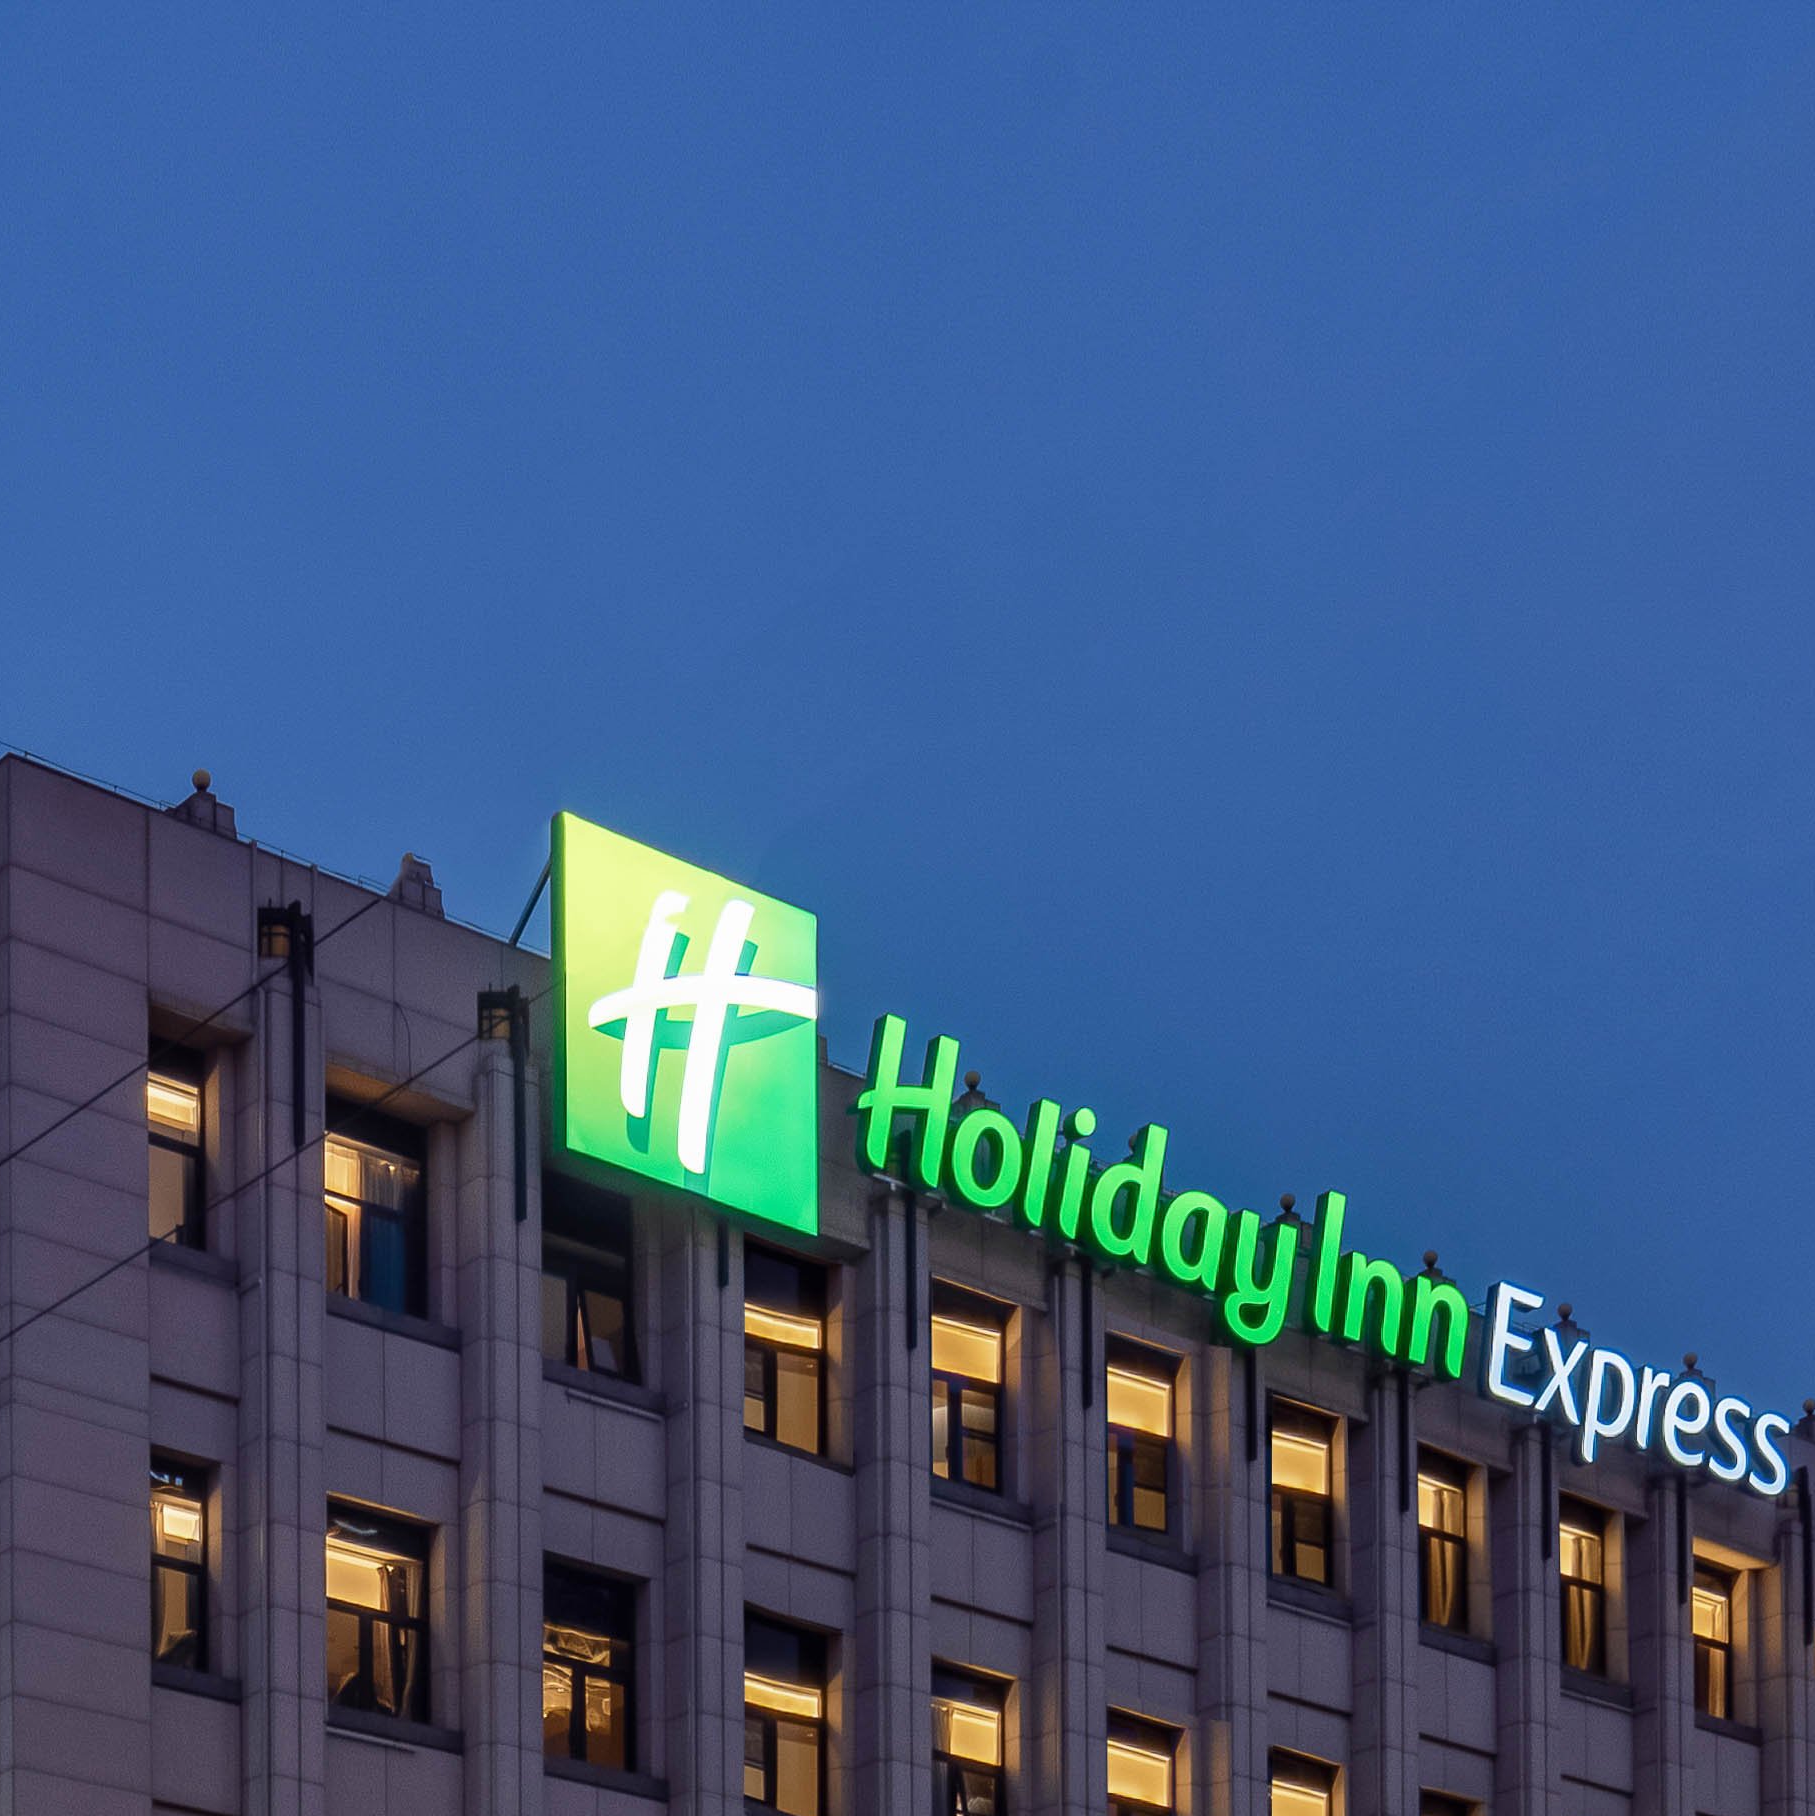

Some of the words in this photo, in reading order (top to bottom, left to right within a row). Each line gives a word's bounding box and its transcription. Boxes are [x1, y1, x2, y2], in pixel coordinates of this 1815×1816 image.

[858, 1013, 1296, 1346] Holiday
[1316, 1188, 1468, 1380] Inn
[1485, 1280, 1791, 1496] Express
